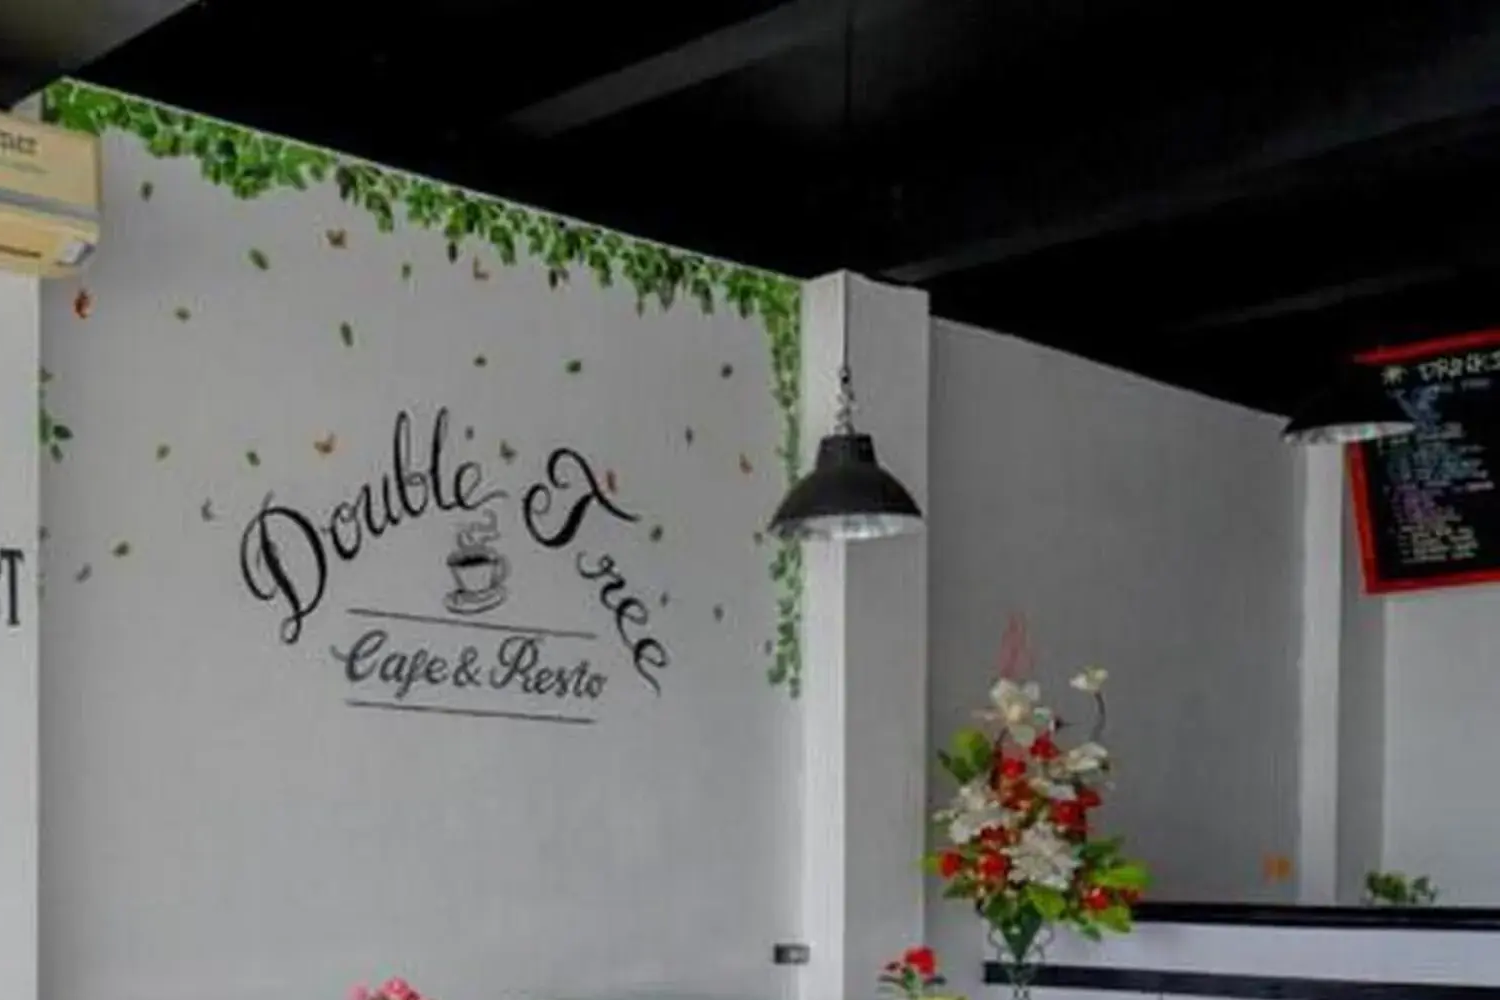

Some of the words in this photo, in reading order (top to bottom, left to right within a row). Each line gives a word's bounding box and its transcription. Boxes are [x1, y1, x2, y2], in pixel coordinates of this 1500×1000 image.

[240, 406, 509, 645] Double
[522, 446, 669, 698] Tree
[330, 629, 448, 700] Cafe
[489, 634, 607, 700] Resto
